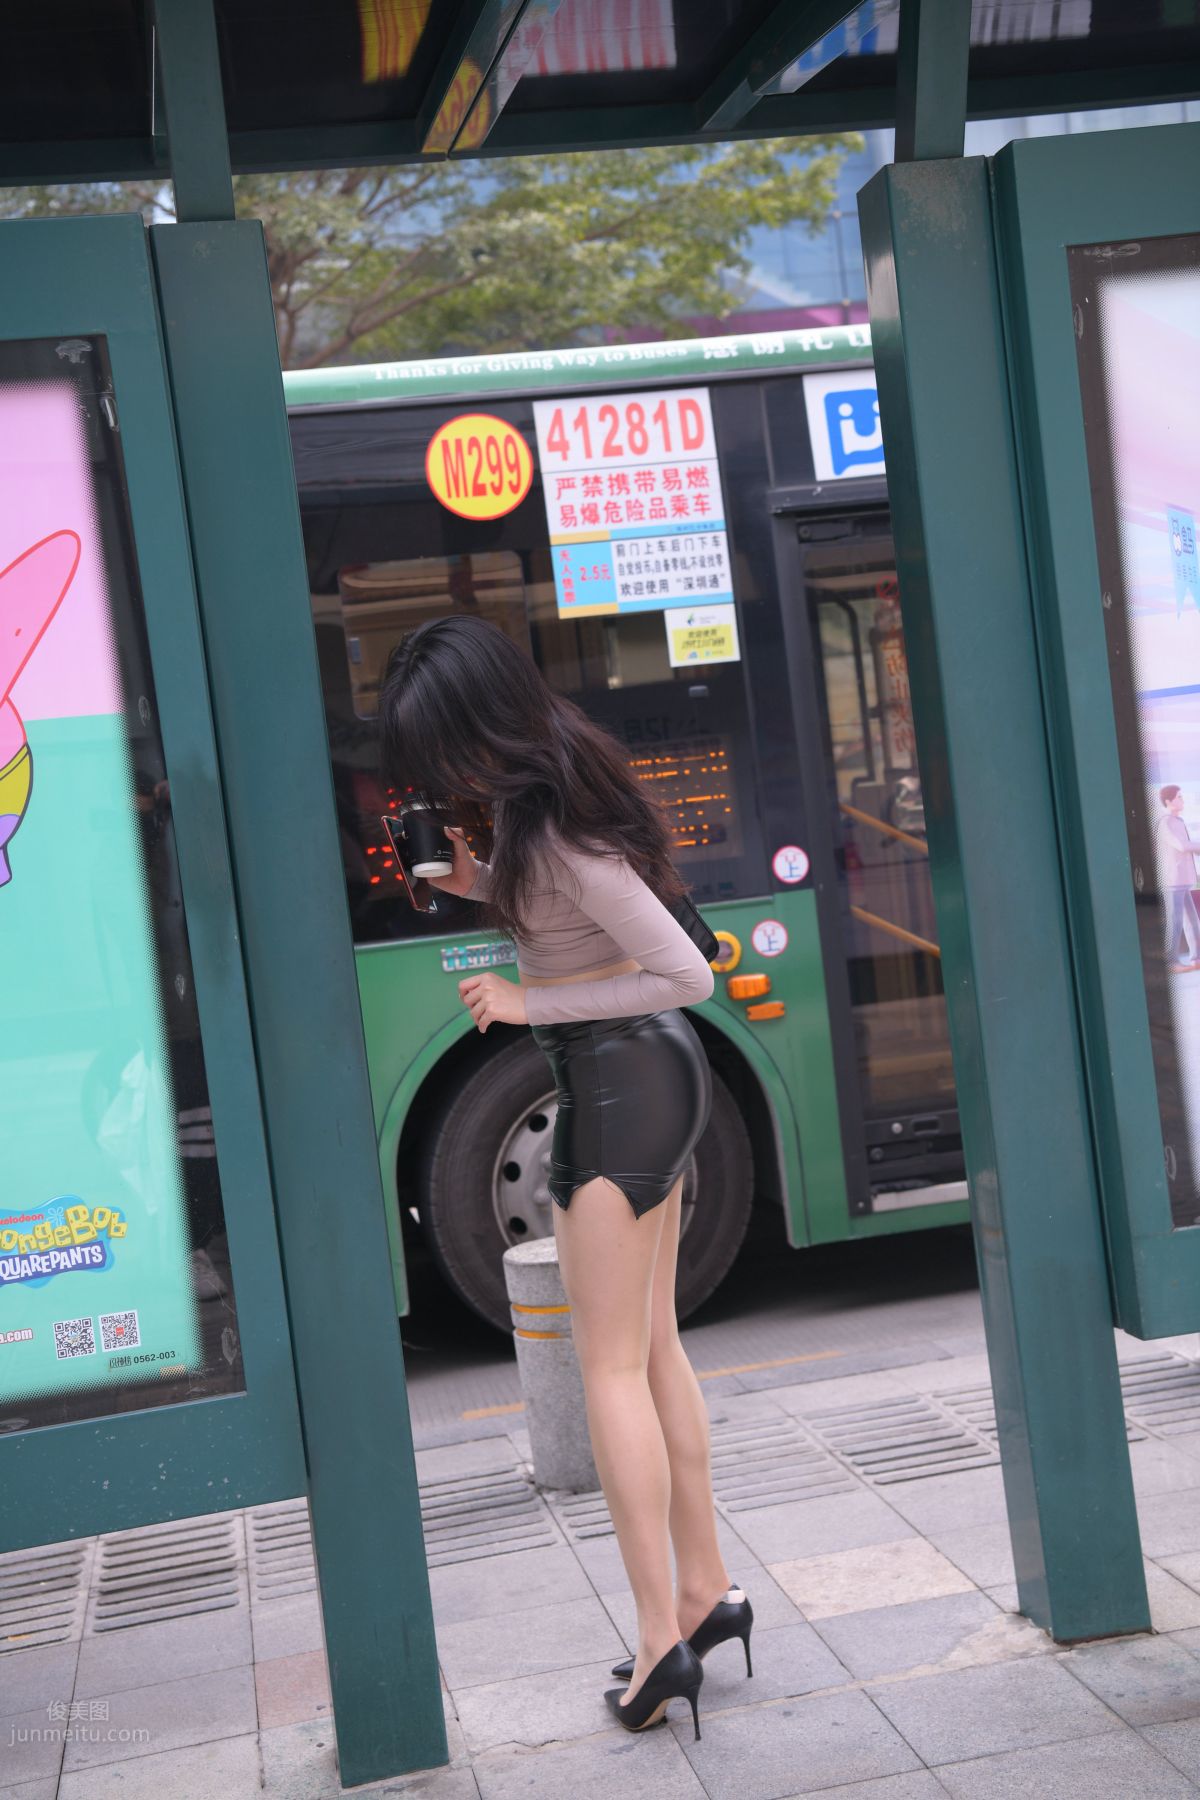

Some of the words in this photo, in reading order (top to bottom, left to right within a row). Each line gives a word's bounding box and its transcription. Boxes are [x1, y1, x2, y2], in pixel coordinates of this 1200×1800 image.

[370, 364, 447, 379] Thanks
[452, 361, 482, 374] for
[487, 356, 554, 370] Giving
[558, 351, 598, 366] Way
[602, 349, 625, 362] to
[629, 346, 688, 360] Buses
[546, 398, 705, 461] 41281D
[441, 433, 522, 499] M299
[555, 465, 710, 501] 严禁携带易燃
[560, 493, 712, 528] 易爆危险品乘车
[579, 563, 612, 583] 2.5元
[620, 579, 670, 597] 欢迎使用
[133, 1350, 176, 1365] 0562-003
